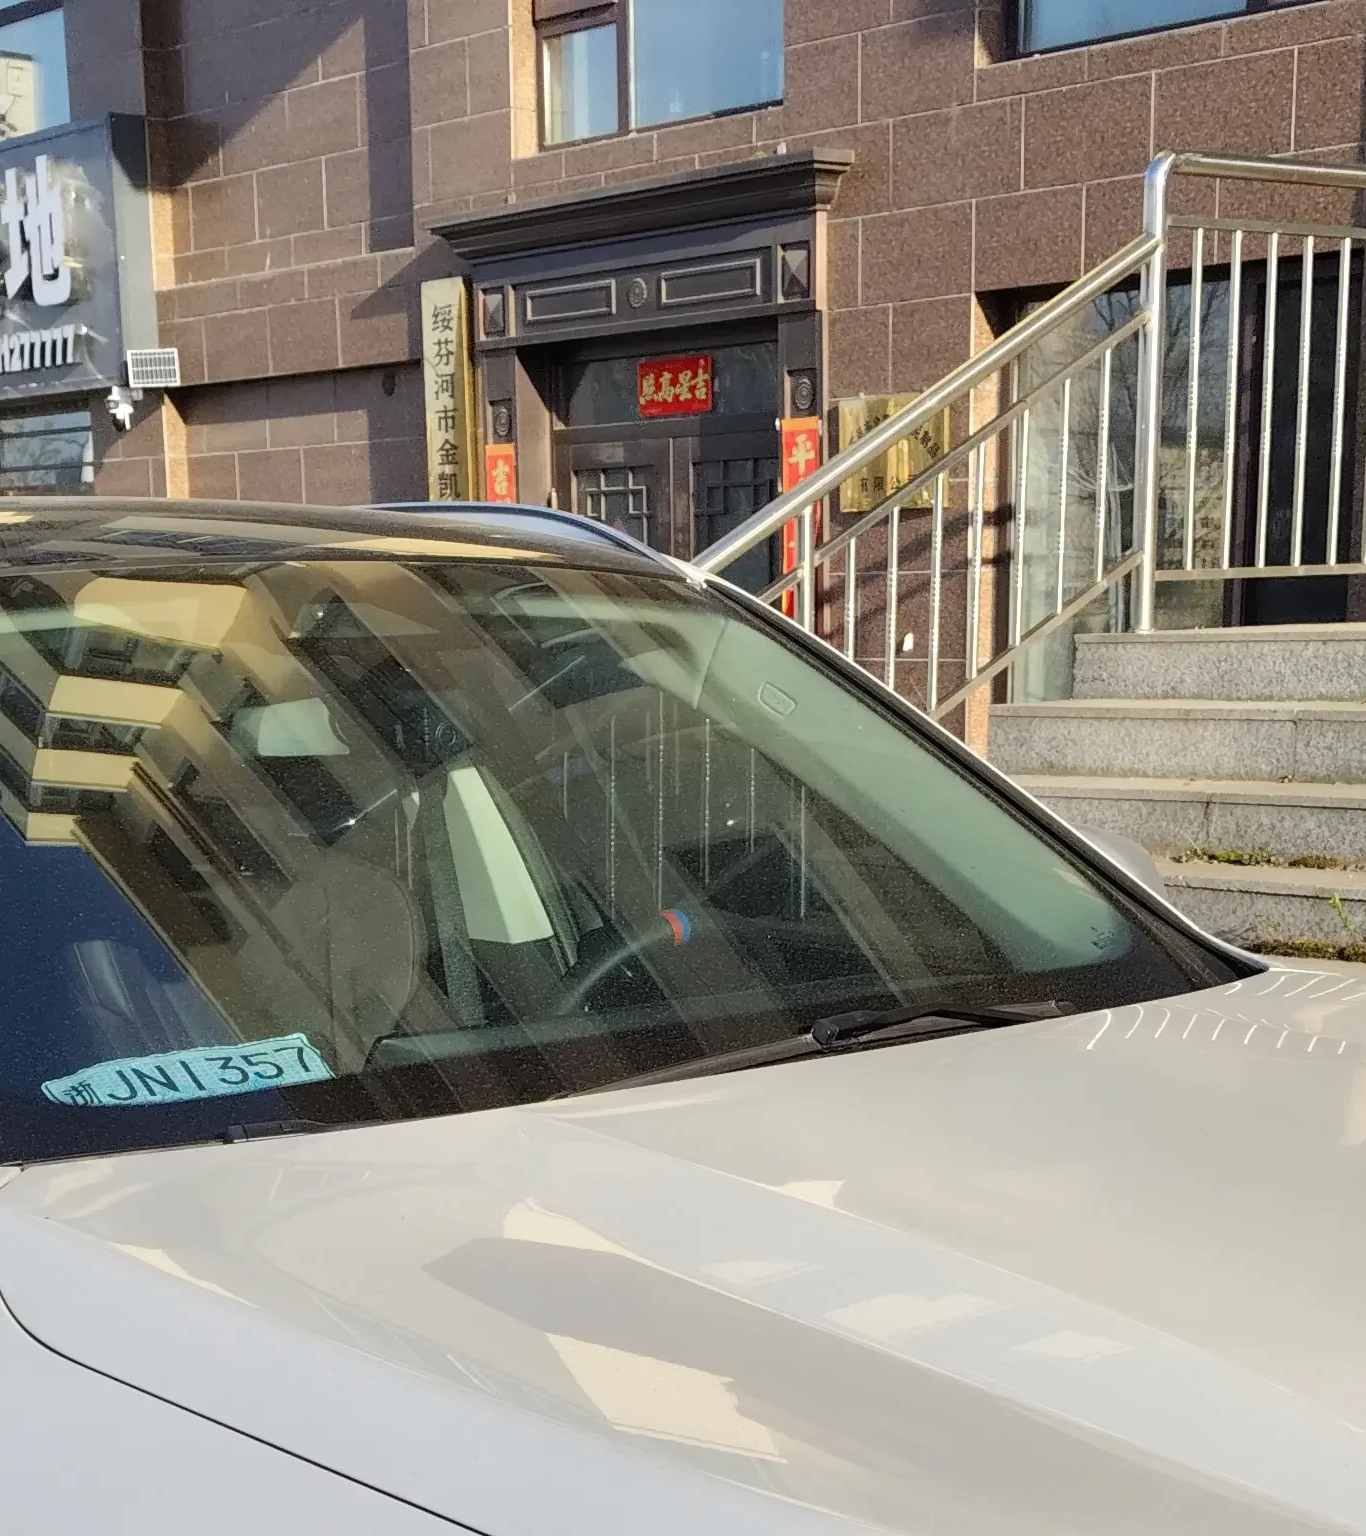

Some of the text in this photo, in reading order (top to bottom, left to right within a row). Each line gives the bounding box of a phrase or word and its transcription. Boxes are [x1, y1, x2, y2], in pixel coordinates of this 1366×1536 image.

[432, 304, 461, 500] 绥芬河市金凯
[787, 433, 816, 481] 平
